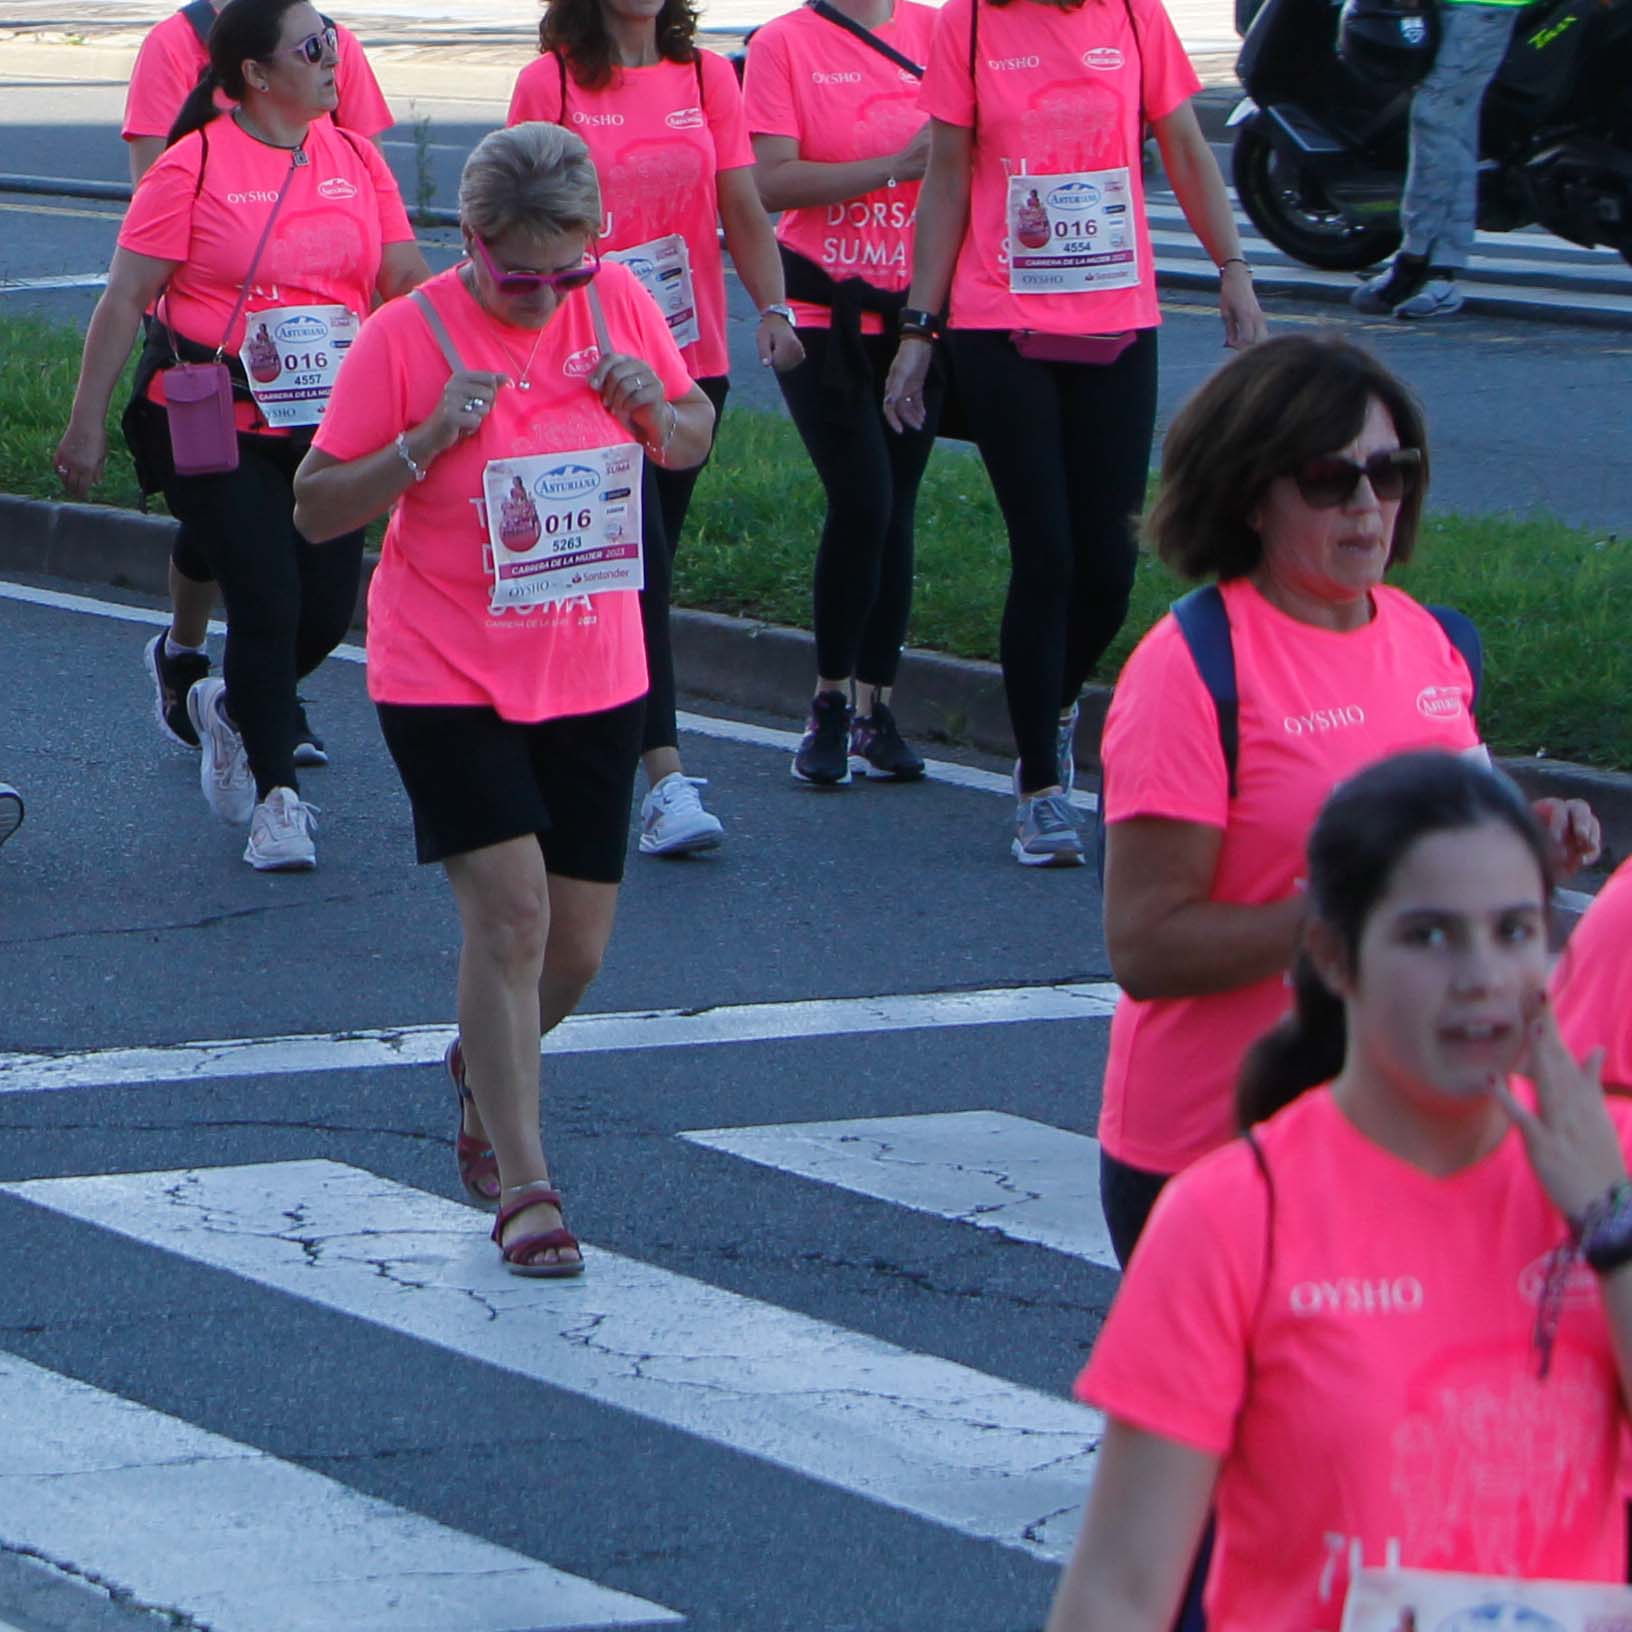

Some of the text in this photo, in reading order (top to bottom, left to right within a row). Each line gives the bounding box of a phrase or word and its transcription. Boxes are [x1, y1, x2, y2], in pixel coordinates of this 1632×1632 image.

[988, 55, 1040, 71] OYSHO
[812, 71, 861, 84] OYSHO
[572, 111, 624, 127] OYSHO
[227, 190, 279, 204] OYSHO
[1050, 193, 1098, 205] ASTURIANA
[1054, 219, 1098, 238] 016
[822, 237, 906, 265] SUMA
[1063, 241, 1091, 253] 4554
[1025, 258, 1063, 267] CARRERA
[1064, 257, 1076, 266] DE
[1077, 257, 1086, 265] LA
[1022, 273, 1064, 285] OYSHO
[279, 326, 325, 338] ASTURIANA
[285, 351, 328, 370] 016
[294, 373, 322, 386] 4557
[259, 391, 294, 402] CARRERA
[295, 390, 306, 399] DE
[307, 389, 316, 398] LA
[539, 477, 596, 495] ASTURIANA
[545, 508, 592, 535] 016
[552, 535, 582, 553] 5263
[512, 560, 550, 575] CARRERA
[551, 559, 563, 568] DE
[563, 556, 574, 566] LA
[575, 551, 603, 563] MUJER
[582, 569, 630, 582] Santander
[508, 580, 550, 598] OYSHO
[1283, 704, 1365, 736] OYSHO
[1290, 1275, 1423, 1316] OYSHO
